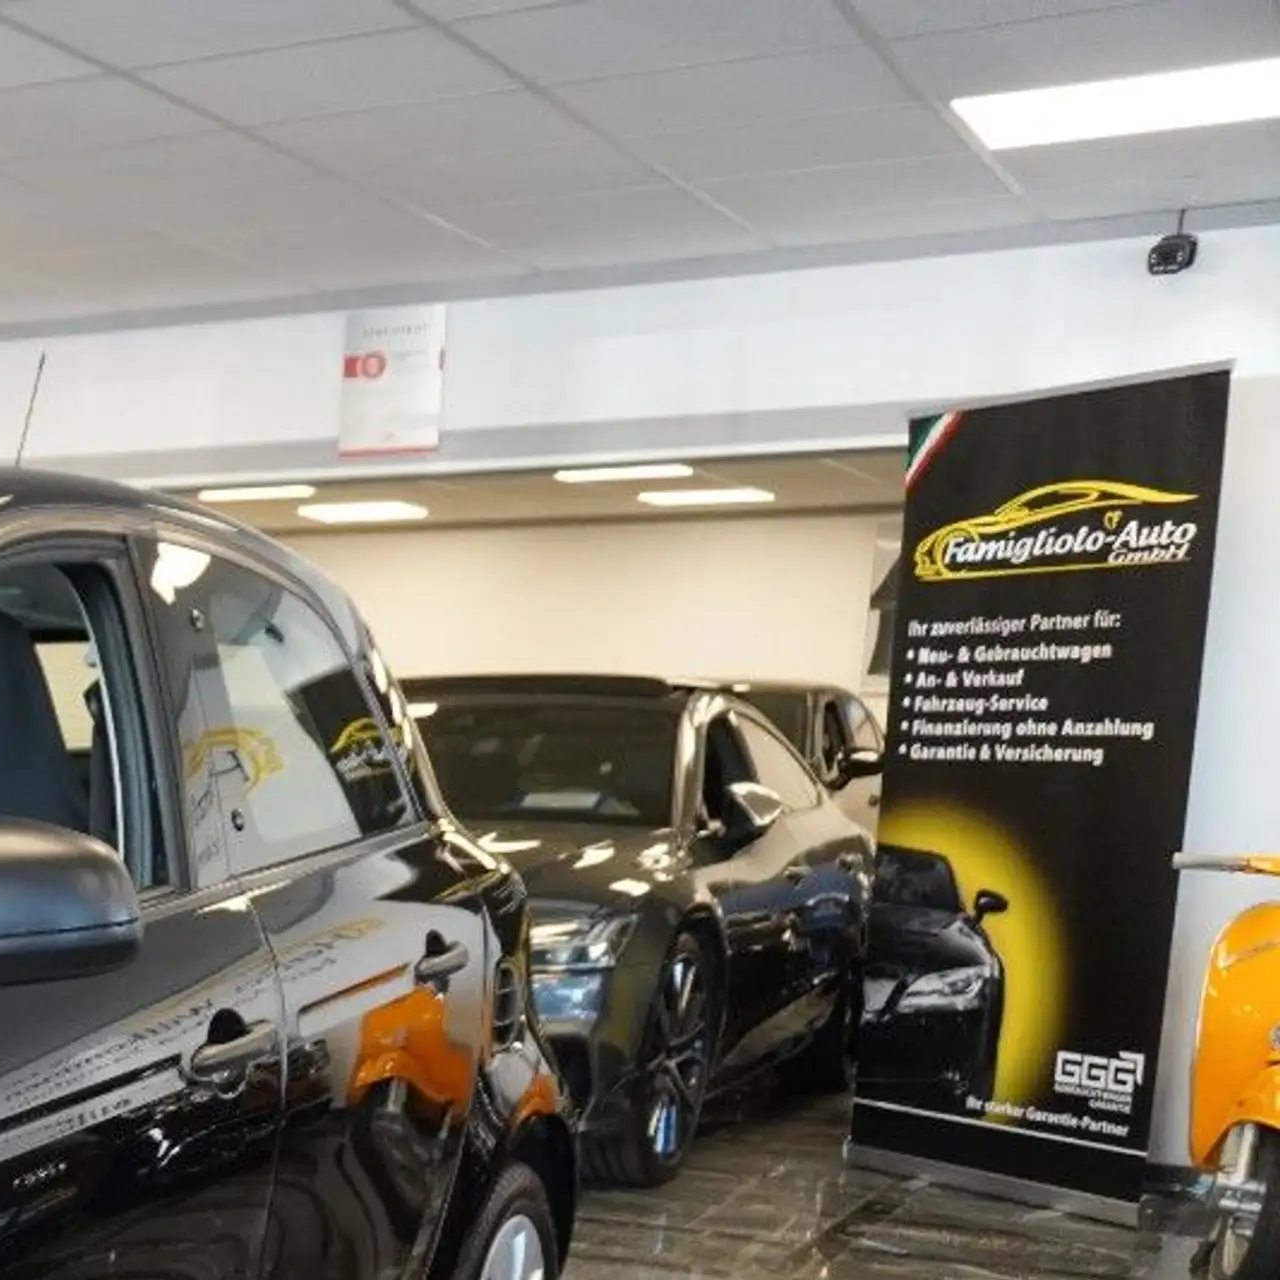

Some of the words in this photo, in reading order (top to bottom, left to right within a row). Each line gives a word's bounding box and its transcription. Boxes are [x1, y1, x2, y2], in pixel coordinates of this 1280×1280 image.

[944, 519, 1198, 564] Famigliolo-Auto
[1107, 543, 1188, 564] GmbH
[908, 619, 929, 637] Ihr
[930, 615, 1026, 637] zuverlässiger
[1030, 613, 1090, 631] Partner
[1093, 609, 1122, 628] für:
[917, 647, 954, 665] Neu-
[956, 645, 971, 664] &
[974, 641, 1113, 664] Gebrauchtwagen
[915, 671, 943, 688] An-
[945, 669, 959, 688] &
[962, 667, 1025, 687] Verkauf
[913, 693, 1049, 717] Fahrzeug-Service
[912, 718, 1013, 740] Finanzierung
[1016, 718, 1058, 736] ohne
[1061, 717, 1155, 741] Anzahlung
[909, 743, 977, 761] Garantie
[978, 743, 992, 761] &
[994, 743, 1105, 767] Versicherung
[1054, 1050, 1137, 1093] GGG
[1026, 1106, 1130, 1137] Garantie-Partner
